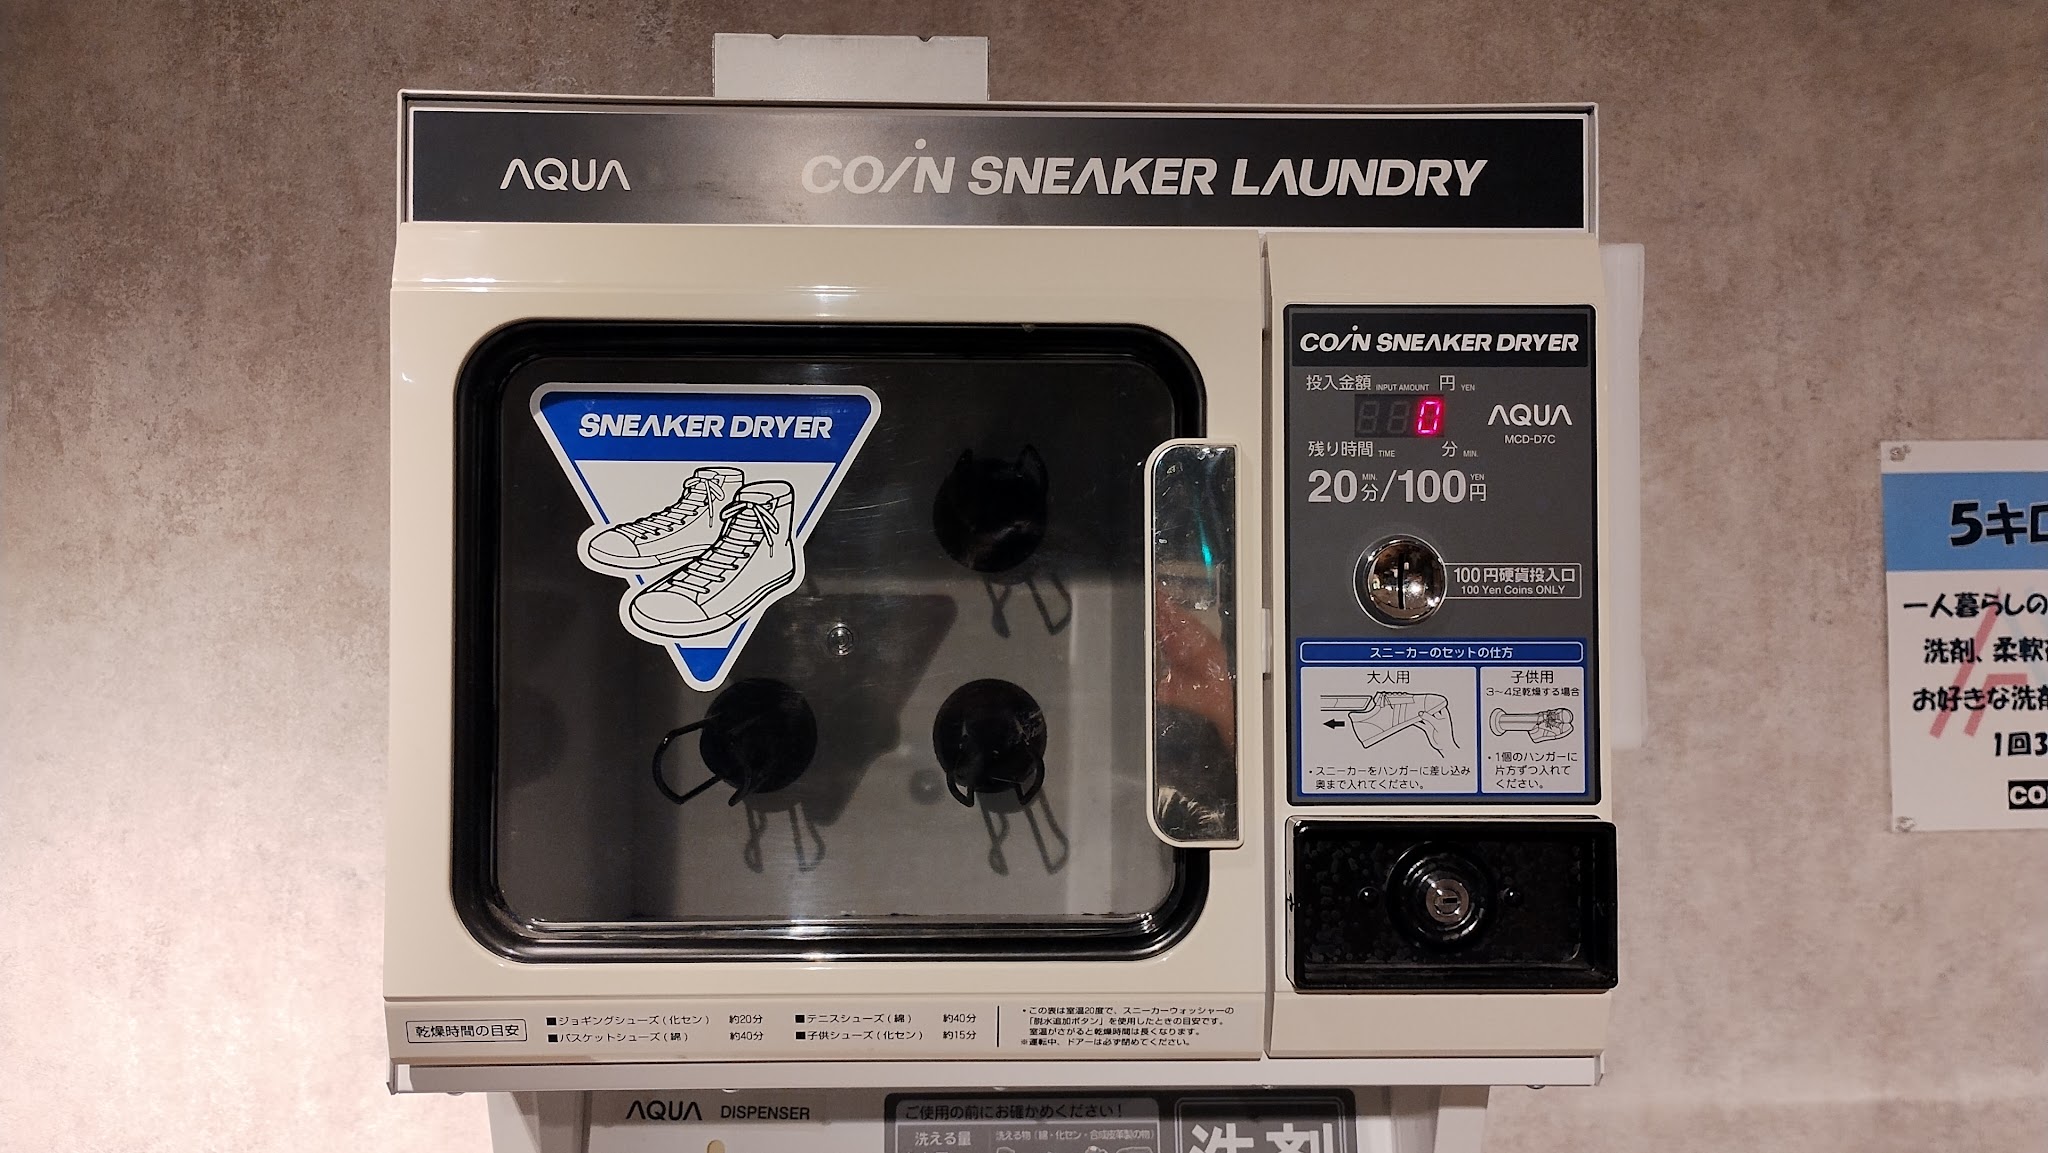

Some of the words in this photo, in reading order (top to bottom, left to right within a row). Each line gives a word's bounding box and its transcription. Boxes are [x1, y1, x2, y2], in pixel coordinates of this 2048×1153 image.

[499, 157, 631, 192] AQUA
[800, 137, 956, 195] COIN
[967, 154, 1218, 196] SNEAKER
[1230, 158, 1489, 197] LAUNDRY
[1299, 324, 1372, 352] COIN
[1375, 332, 1493, 353] SNEAKER
[1496, 333, 1579, 352] DRYER
[1306, 373, 1372, 392] 投入金額
[1375, 383, 1397, 392] INPUT
[1398, 383, 1430, 392] AMOUNT
[1438, 374, 1456, 392] 円
[1460, 383, 1476, 392] YEN
[1487, 403, 1573, 427] AQUA
[578, 412, 726, 439] SNEAKER
[729, 415, 833, 440] DRYER
[1503, 433, 1556, 445] MCD-D7C
[1308, 440, 1374, 458] 残り時間
[1378, 449, 1396, 458] TIME
[1441, 440, 1458, 459] 分
[1462, 449, 1479, 458] MIN.
[1469, 473, 1485, 481] YEN
[1453, 566, 1577, 583] 100円硬貨投入口
[1461, 584, 1480, 595] 100
[1481, 585, 1502, 595] Yen
[1503, 584, 1534, 595] Coins
[1535, 584, 1566, 595] ONLY
[1903, 592, 2048, 618] 一人暮らしの
[1369, 646, 1514, 659] スニーカーのセットの仕方
[1923, 636, 2048, 664] 洗剤、柔軟
[1366, 670, 1410, 685] 大人用
[1510, 669, 1554, 684] 子供用
[1495, 764, 1571, 776] 片方ずつ入れて
[1315, 779, 1424, 790] 奥まで入れてください。
[1496, 778, 1544, 789] ください。
[729, 1014, 763, 1025] 約20分
[942, 1013, 977, 1024] 約40分
[415, 1024, 520, 1038] 乾燥時間の目安
[729, 1031, 764, 1041] 約40分
[942, 1030, 977, 1040] 約15分
[625, 1099, 703, 1122] AQUA
[720, 1104, 810, 1121] DISPENSER
[914, 1130, 972, 1147] 洗える量
